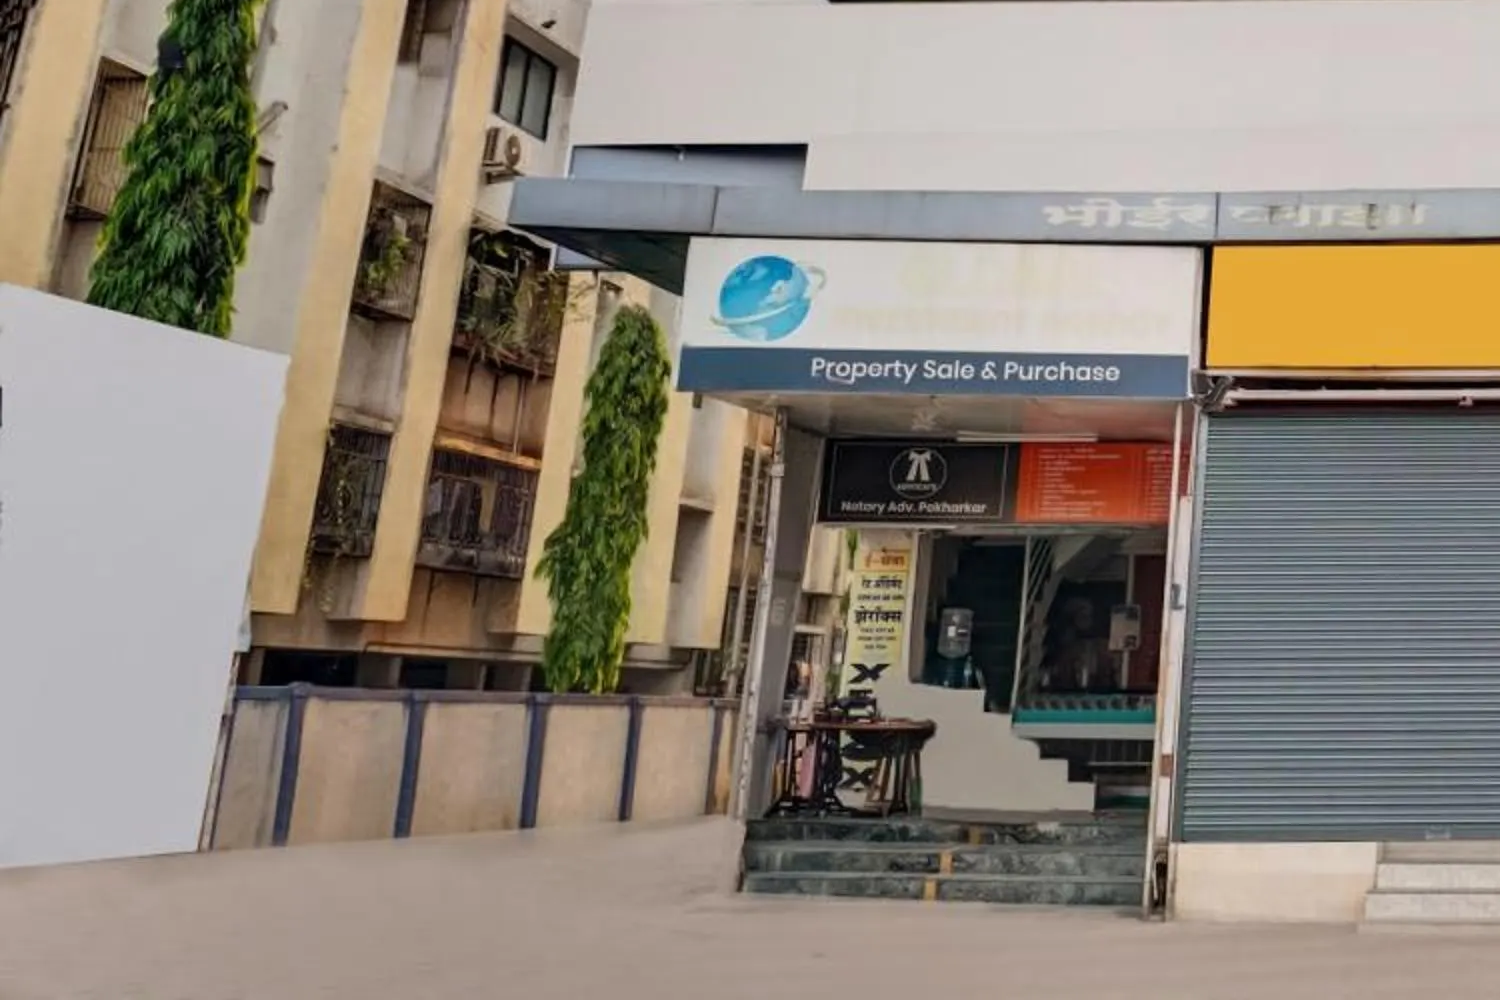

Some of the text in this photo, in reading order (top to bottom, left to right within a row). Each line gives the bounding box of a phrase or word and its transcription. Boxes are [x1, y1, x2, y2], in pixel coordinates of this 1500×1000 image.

[811, 357, 1121, 384] Property Sale & Purchase
[841, 502, 886, 515] Notary
[887, 502, 917, 513] Adv.
